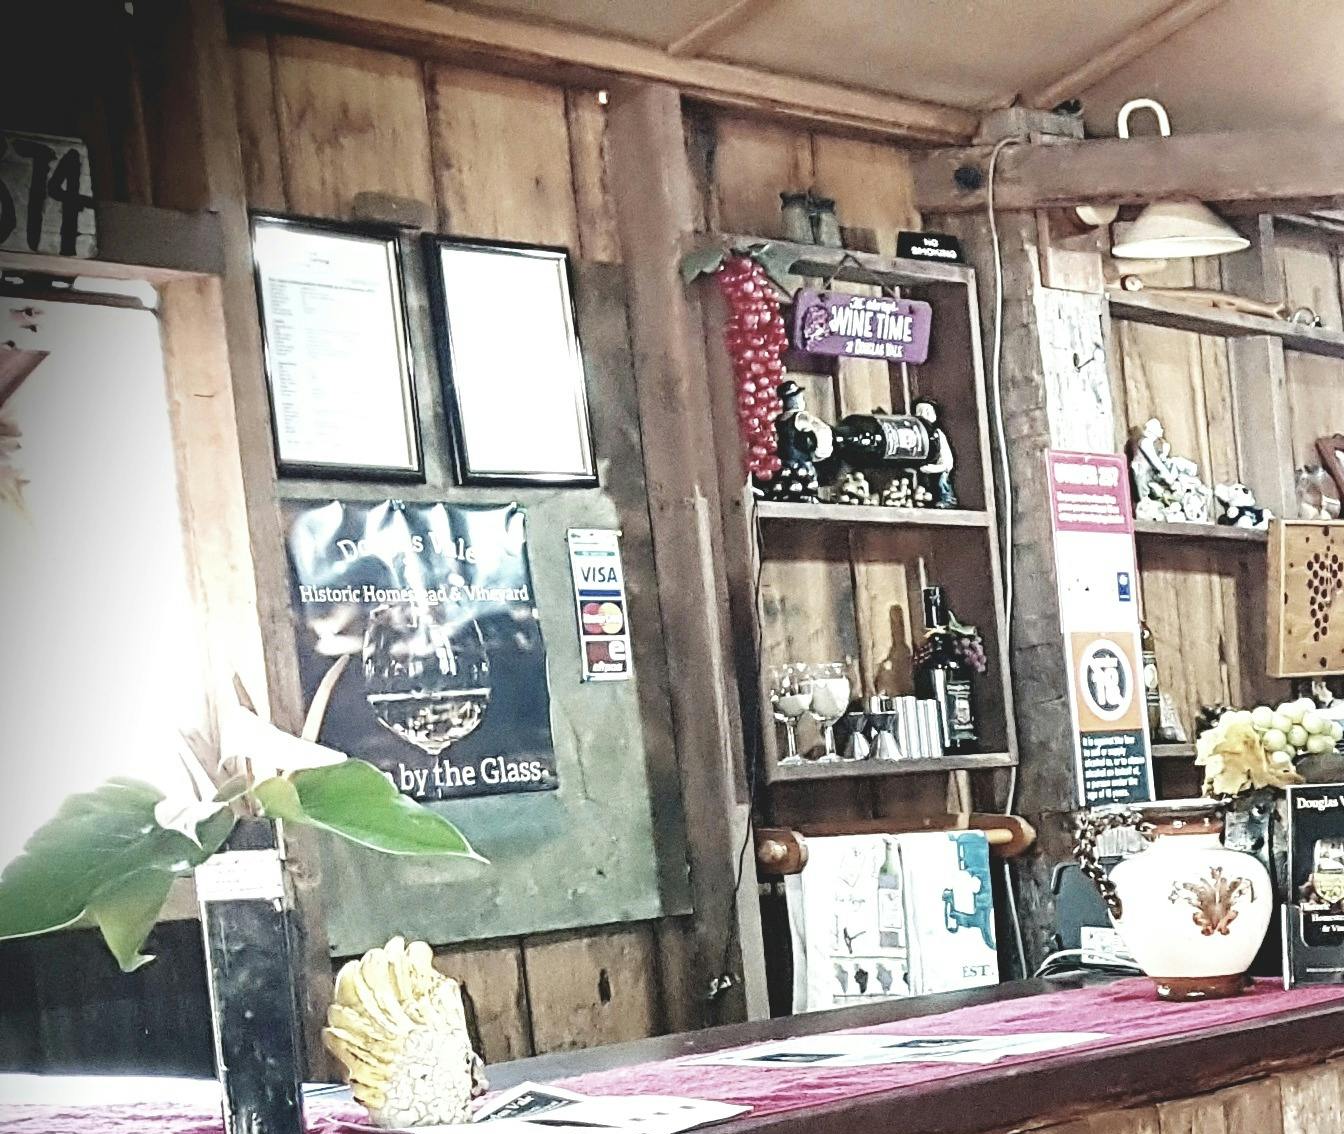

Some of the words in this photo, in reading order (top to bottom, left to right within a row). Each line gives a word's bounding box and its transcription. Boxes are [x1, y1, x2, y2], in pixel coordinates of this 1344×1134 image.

[829, 305, 873, 338] WINE
[877, 312, 912, 342] TIME
[581, 566, 618, 583] VISA
[299, 584, 362, 603] Historic
[399, 763, 429, 796] by
[433, 758, 476, 788] the
[1297, 795, 1338, 812] Douglas
